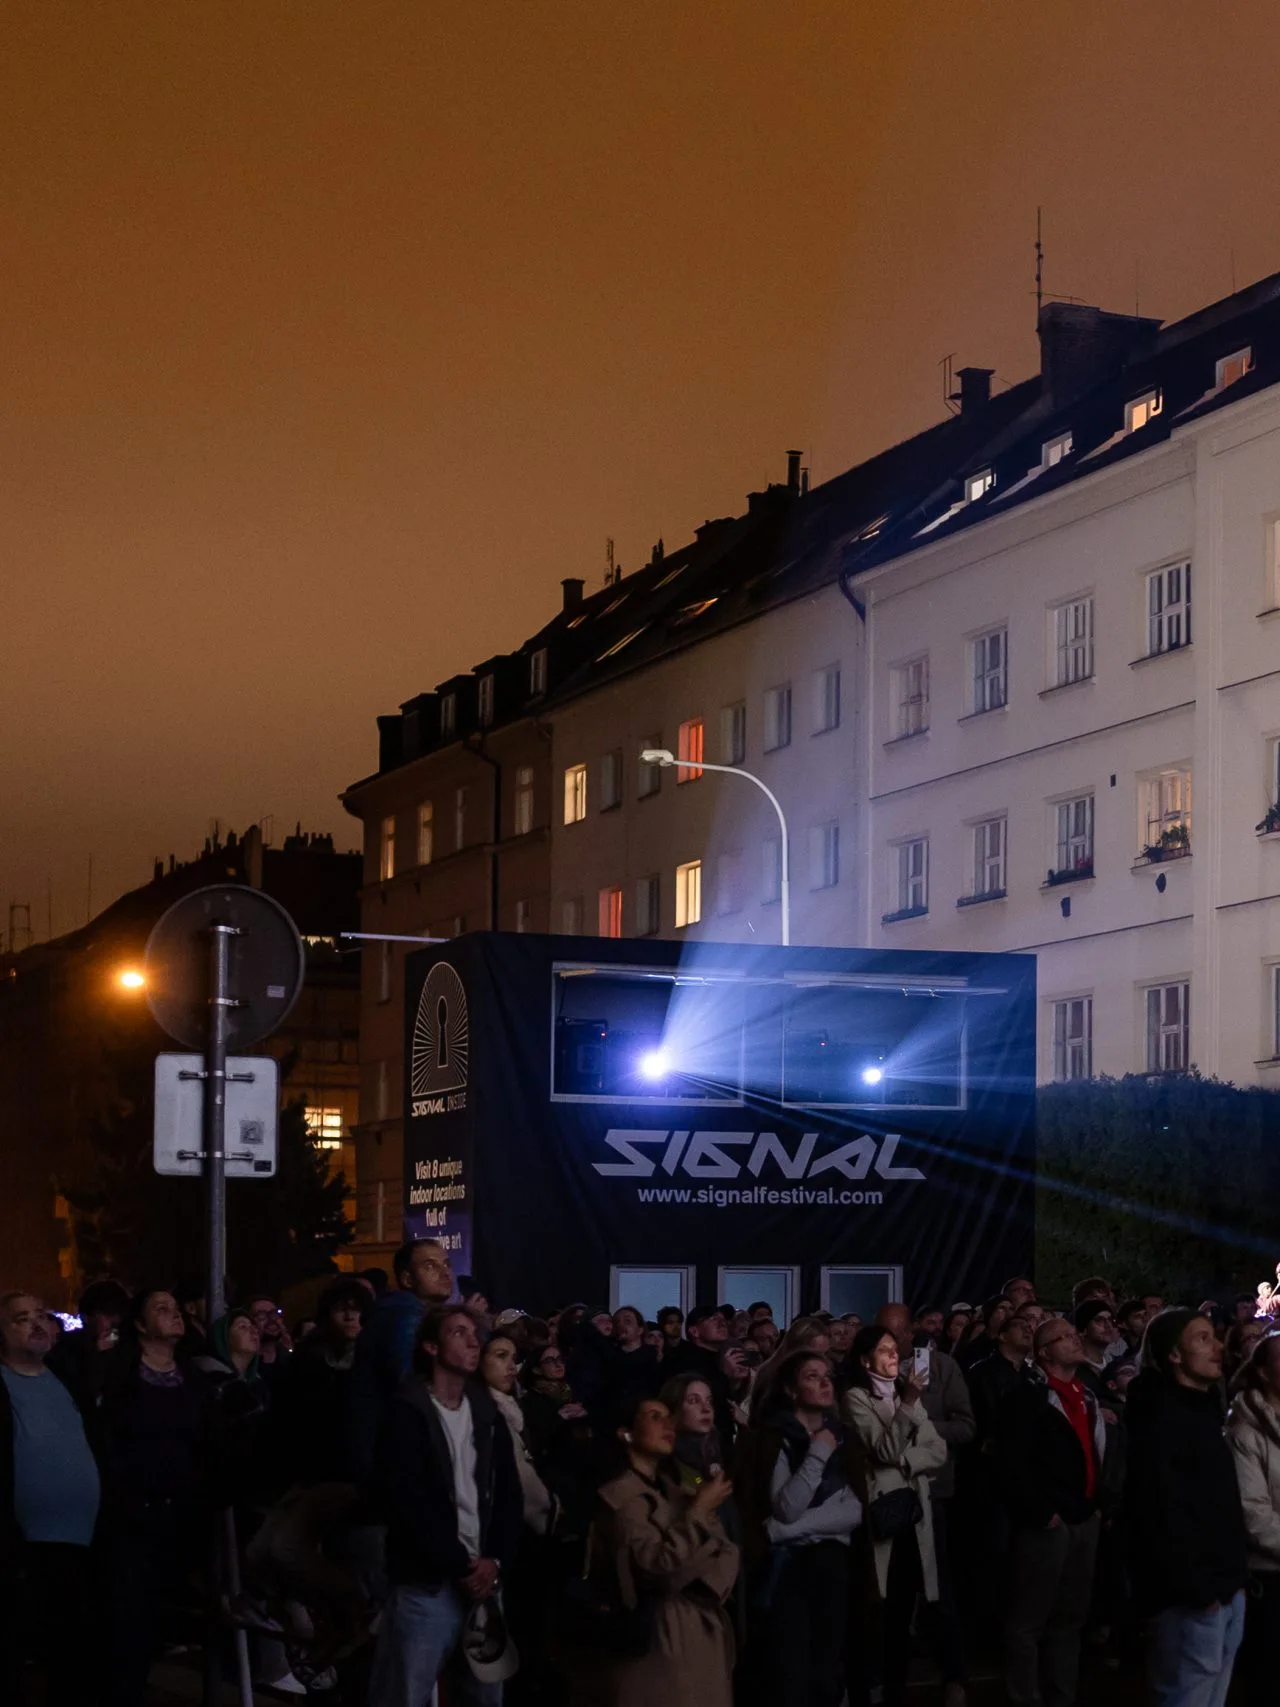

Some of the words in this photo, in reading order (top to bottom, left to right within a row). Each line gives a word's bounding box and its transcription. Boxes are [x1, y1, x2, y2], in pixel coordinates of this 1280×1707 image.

[411, 1097, 446, 1117] SIGNAL
[591, 1128, 928, 1180] SIGNAL
[415, 1160, 431, 1180] Visit
[432, 1159, 439, 1178] 8
[439, 1156, 463, 1178] unique
[409, 1185, 433, 1205] indoor
[433, 1181, 466, 1203] locations
[637, 1185, 884, 1207] www.signalfestival.com
[426, 1208, 438, 1227] full
[438, 1206, 447, 1226] of
[451, 1232, 462, 1249] art
